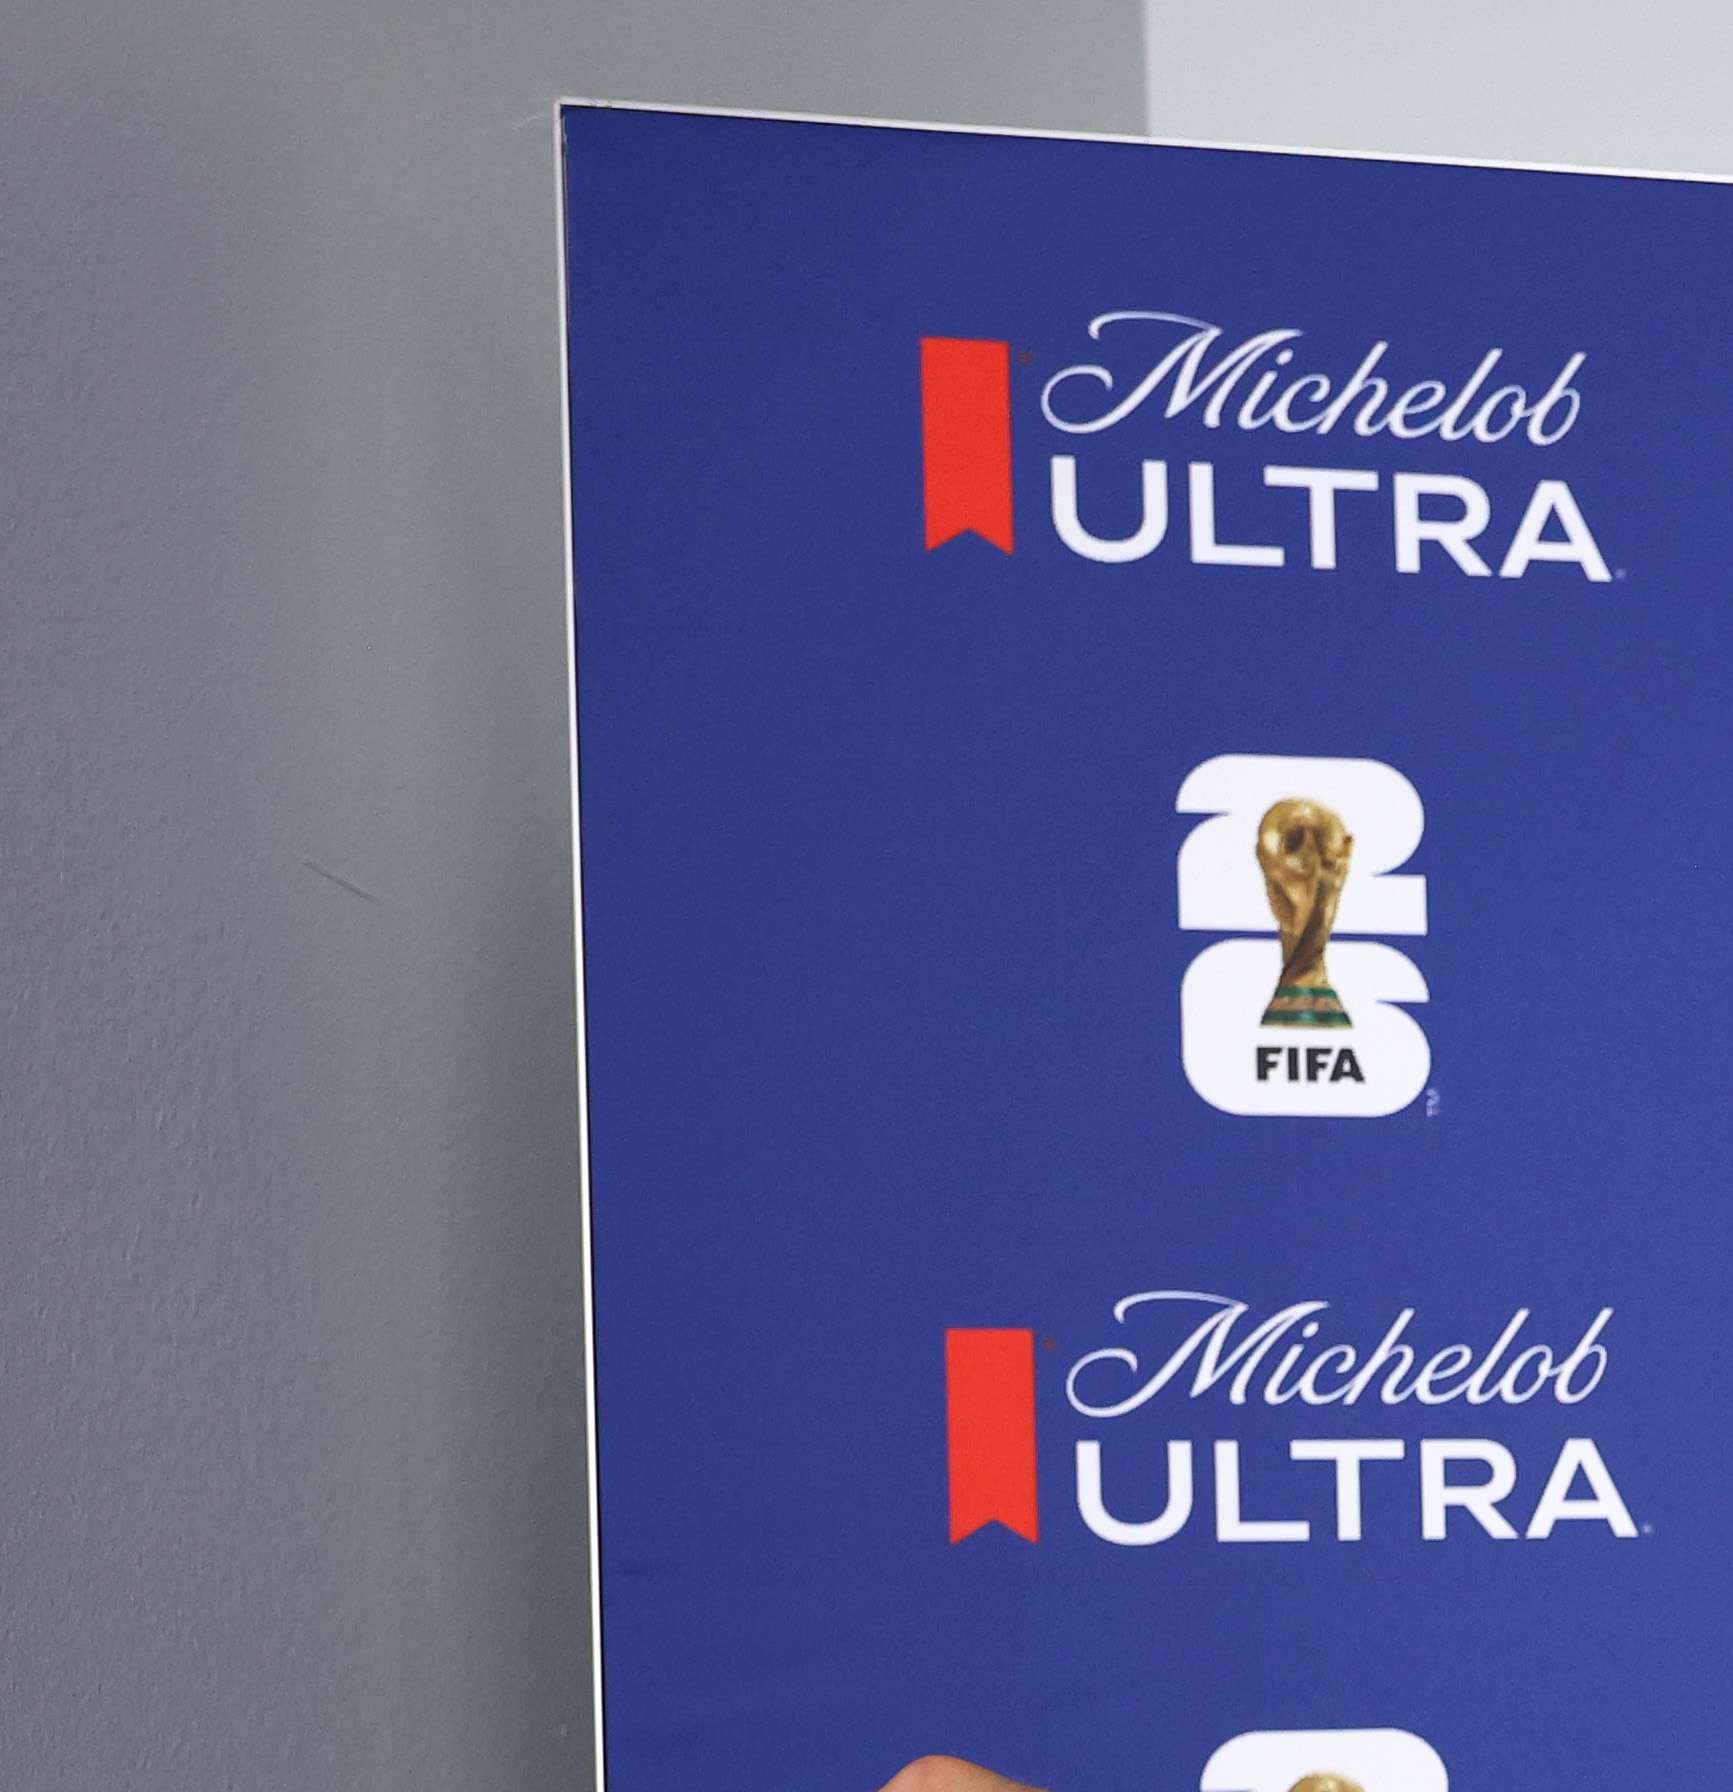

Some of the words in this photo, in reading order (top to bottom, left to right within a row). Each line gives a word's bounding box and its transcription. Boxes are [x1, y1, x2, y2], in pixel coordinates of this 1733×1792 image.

[1042, 312, 1585, 445] Michelob
[1051, 456, 1612, 582] ULTRA
[1257, 1047, 1364, 1082] FIFA
[1067, 1291, 1613, 1417] Michelob
[1076, 1438, 1638, 1545] ULTRA
